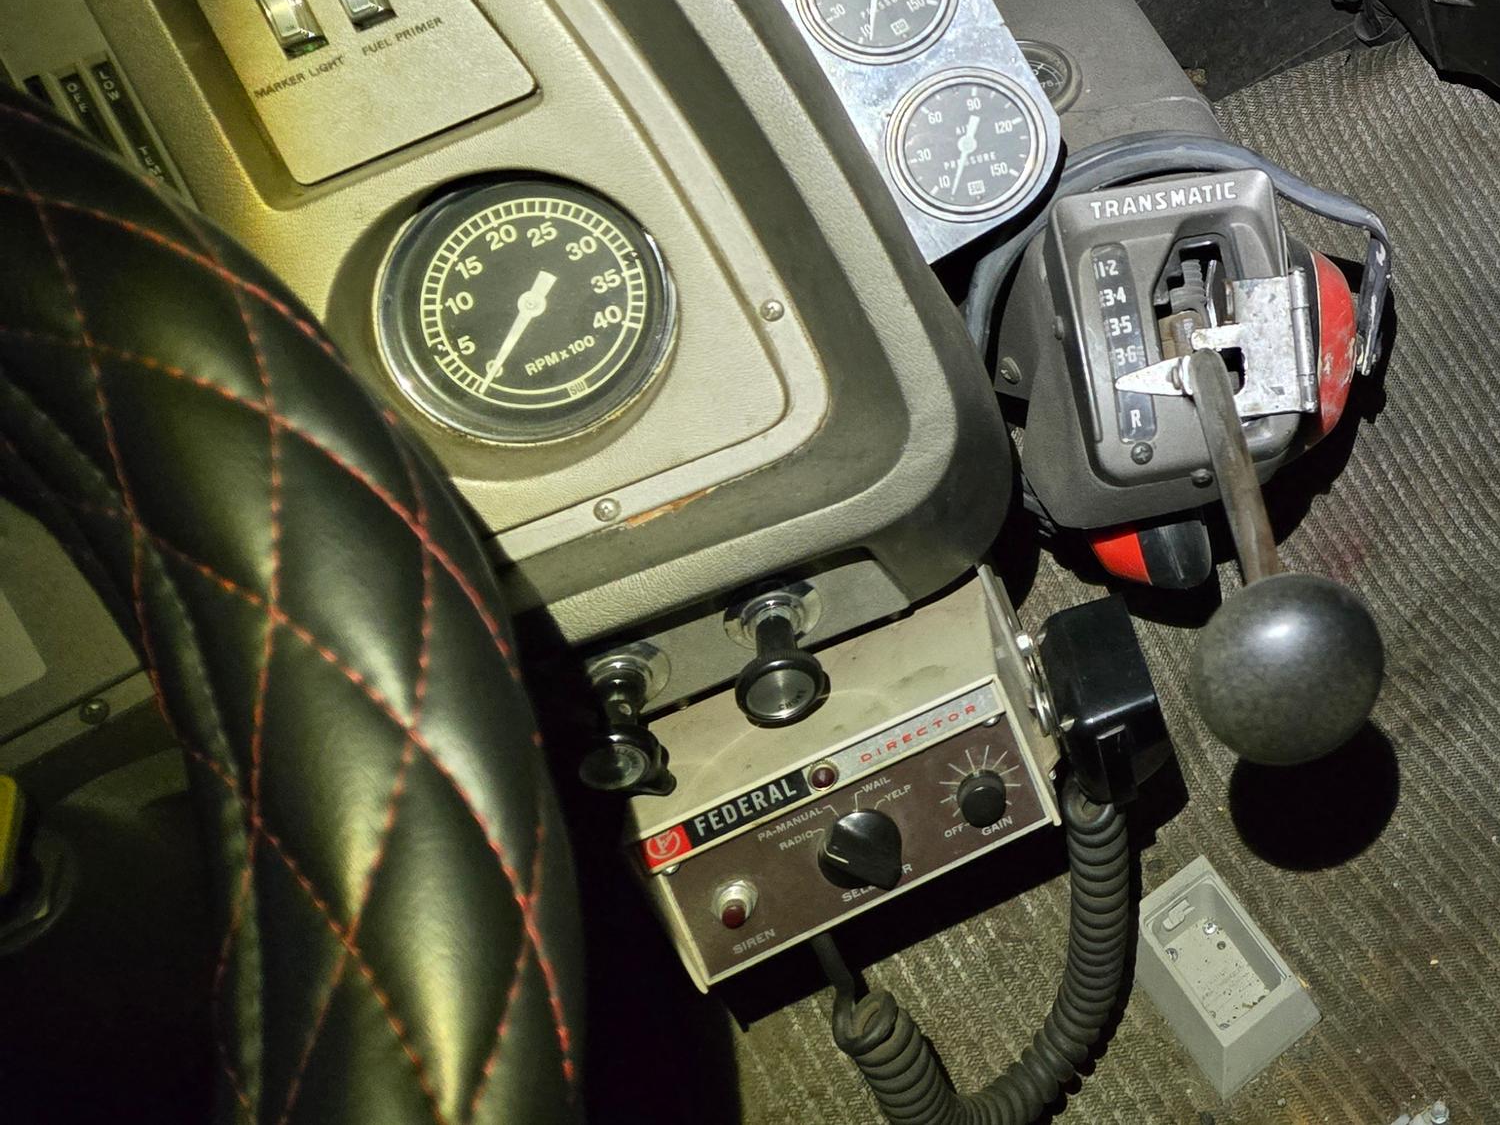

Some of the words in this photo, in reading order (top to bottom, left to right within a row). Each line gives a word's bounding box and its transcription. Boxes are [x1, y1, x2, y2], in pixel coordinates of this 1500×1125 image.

[829, 3, 846, 19] 30
[361, 38, 393, 56] FUEL
[395, 16, 444, 42] PRIMER
[860, 24, 872, 38] 10
[99, 70, 120, 102] LOW
[254, 72, 306, 99] MARKER
[308, 55, 345, 76] LIGHT
[66, 82, 89, 113] OFF
[966, 98, 982, 111] 90
[928, 111, 942, 125] 60
[995, 120, 1013, 135] 120
[916, 148, 932, 162] 30
[989, 162, 1009, 177] 150
[938, 175, 951, 189] 10
[1090, 181, 1237, 220] TRANSMATIC
[485, 224, 518, 252] 20
[526, 221, 558, 248] 25
[565, 235, 598, 261] 30
[454, 255, 484, 280] 15
[590, 268, 622, 294] 35
[445, 291, 474, 315] 10
[592, 305, 623, 330] 40
[457, 335, 476, 356] 5
[1130, 409, 1142, 429] R
[693, 778, 798, 837] FEDERAL
[859, 704, 977, 764] DIRECTOR
[862, 776, 892, 794] WAIL
[884, 784, 913, 803] YELP
[757, 807, 824, 843] PA-MANUAL
[944, 823, 965, 839] OFF
[981, 816, 1014, 837] GAIN
[778, 830, 815, 851] RADIO
[732, 928, 776, 955] SIREN
